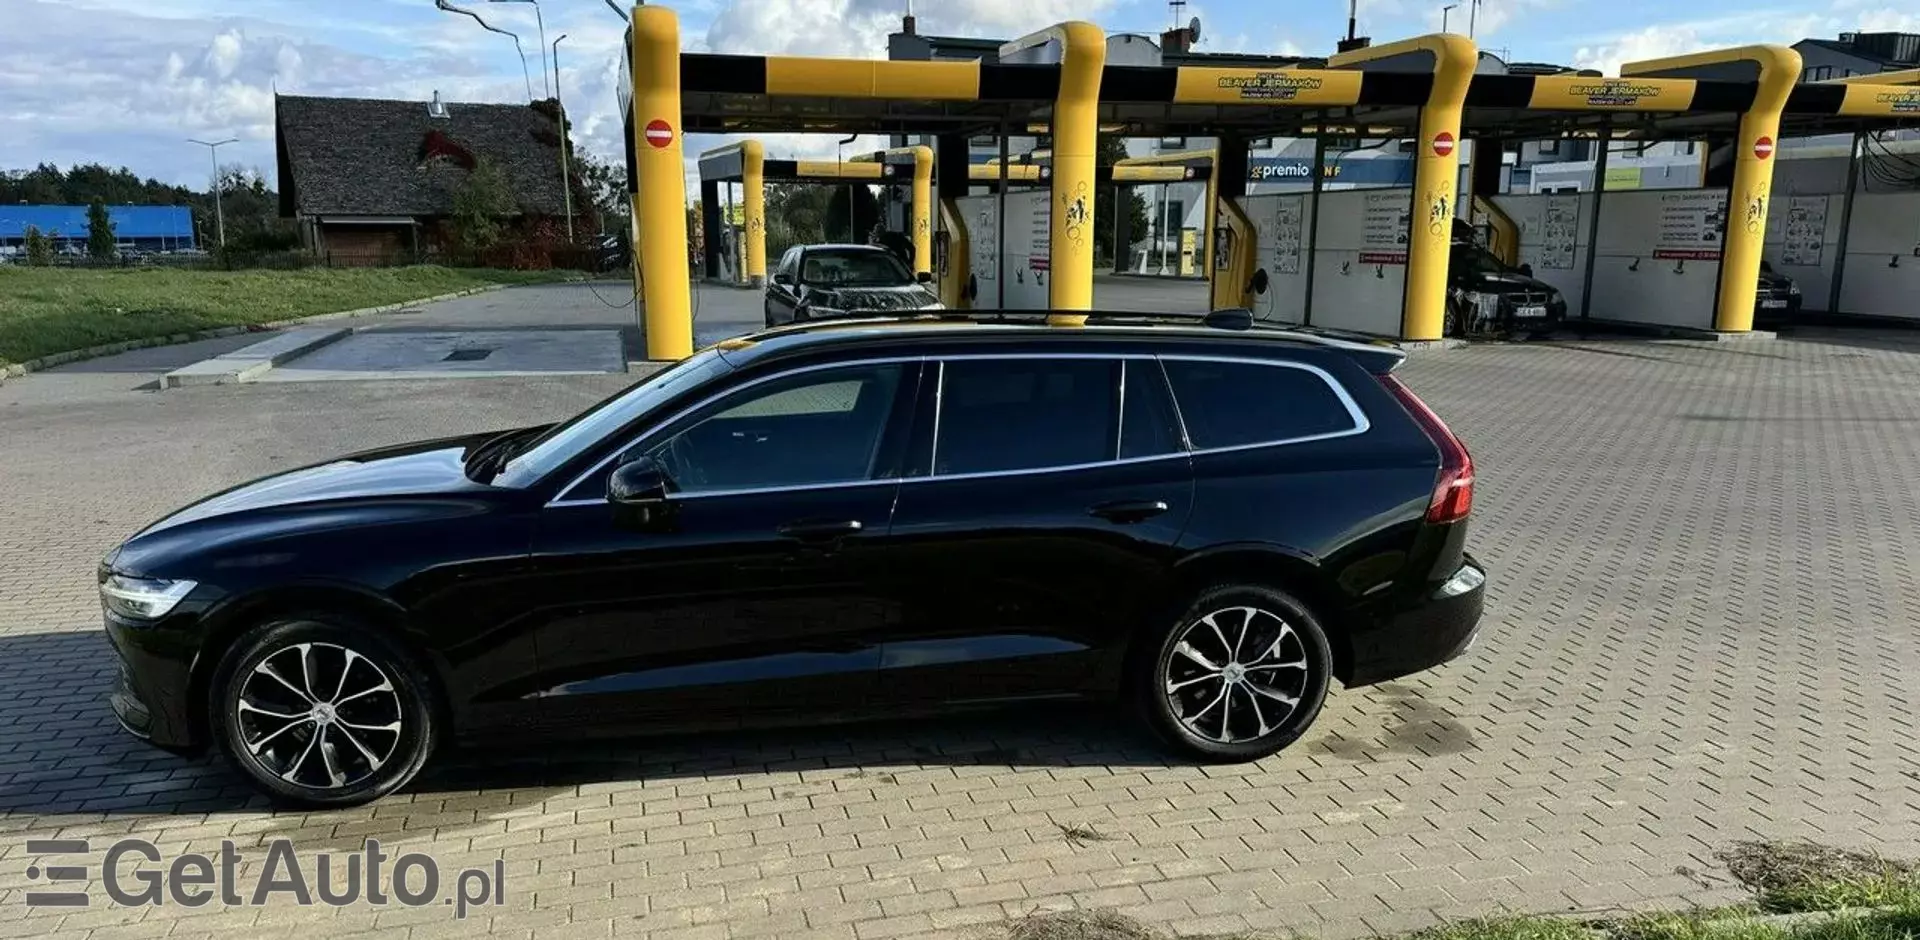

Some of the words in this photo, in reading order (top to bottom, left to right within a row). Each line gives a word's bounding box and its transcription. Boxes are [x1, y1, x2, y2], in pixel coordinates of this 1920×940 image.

[1218, 77, 1261, 88] BEAVER
[1261, 77, 1321, 89] JERMAKÓW
[1570, 86, 1607, 95] BEAVER
[1607, 86, 1660, 96] JERMAKÓW
[1262, 163, 1310, 179] premio
